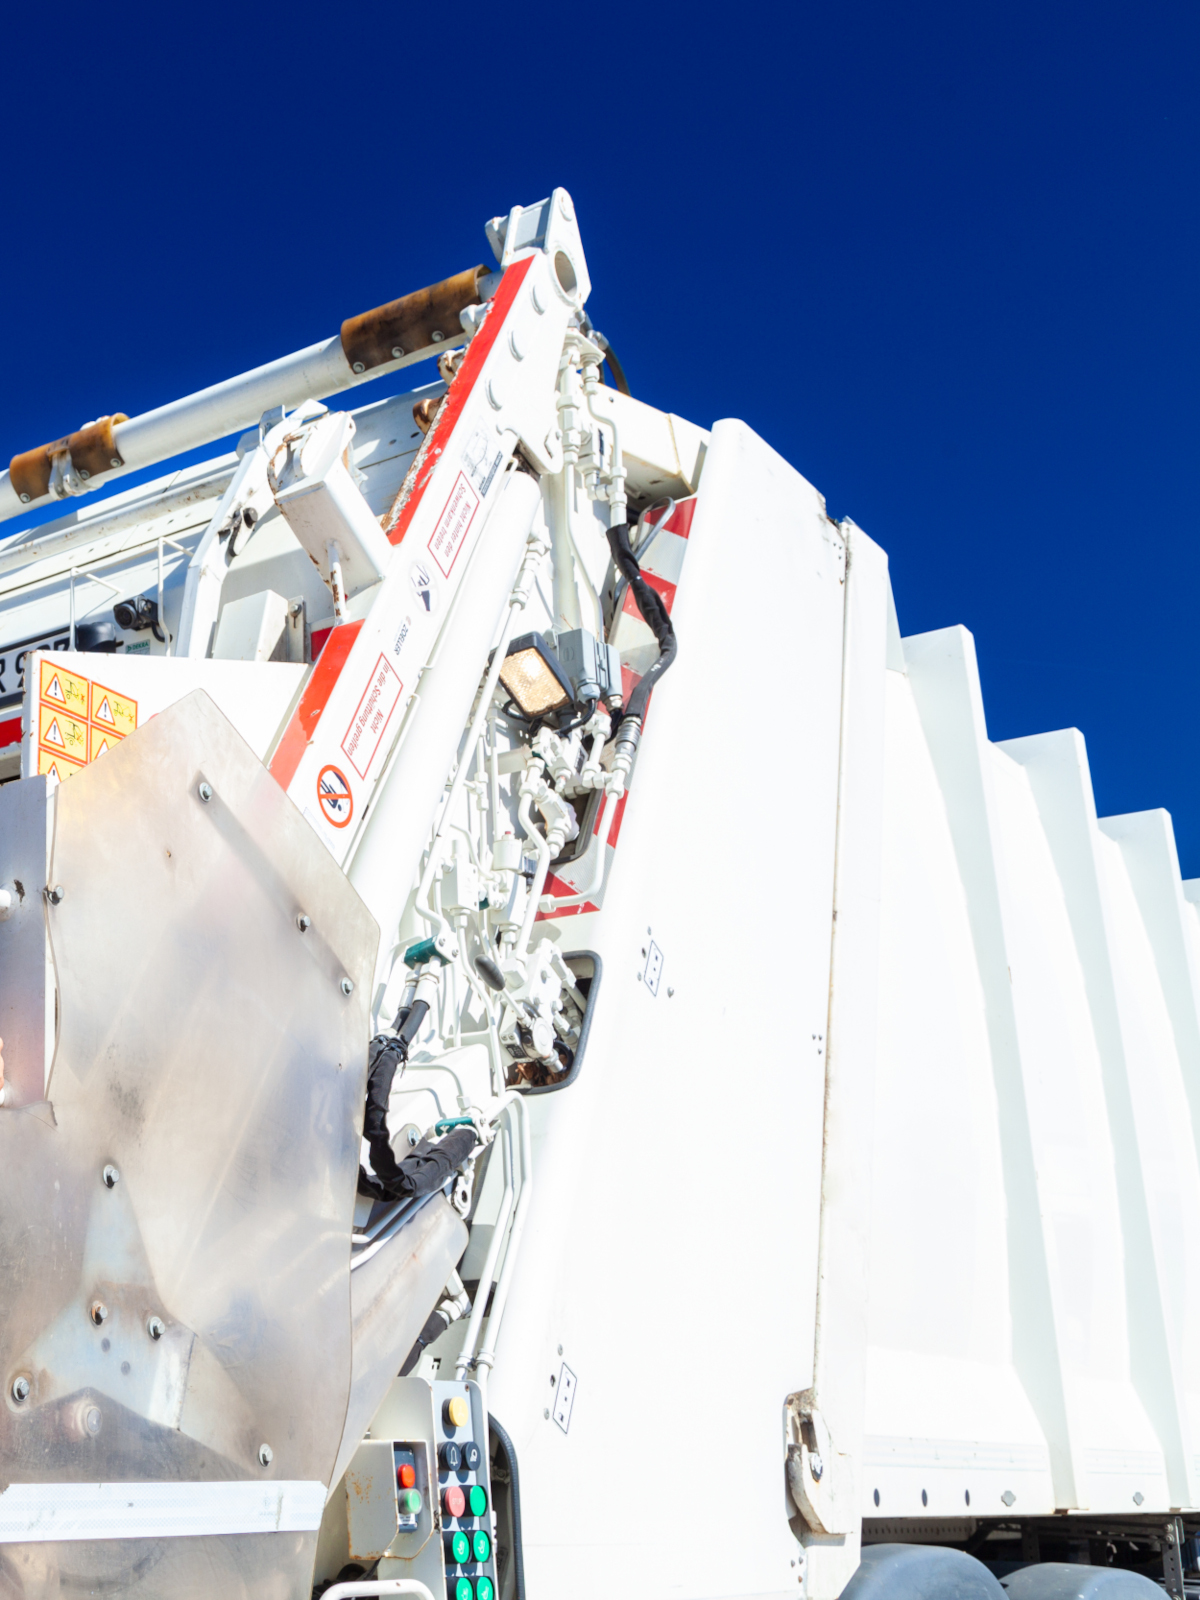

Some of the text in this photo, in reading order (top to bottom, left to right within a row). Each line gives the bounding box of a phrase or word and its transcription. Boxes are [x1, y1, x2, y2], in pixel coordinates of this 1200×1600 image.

[434, 483, 465, 550] Schwenkarm treten
[444, 501, 471, 558] Nicht hinter den
[133, 641, 149, 650] DEKRA
[393, 624, 409, 655] ZOELLER
[346, 662, 390, 757] in die Schüttung greifen
[370, 708, 384, 734] Nicht
